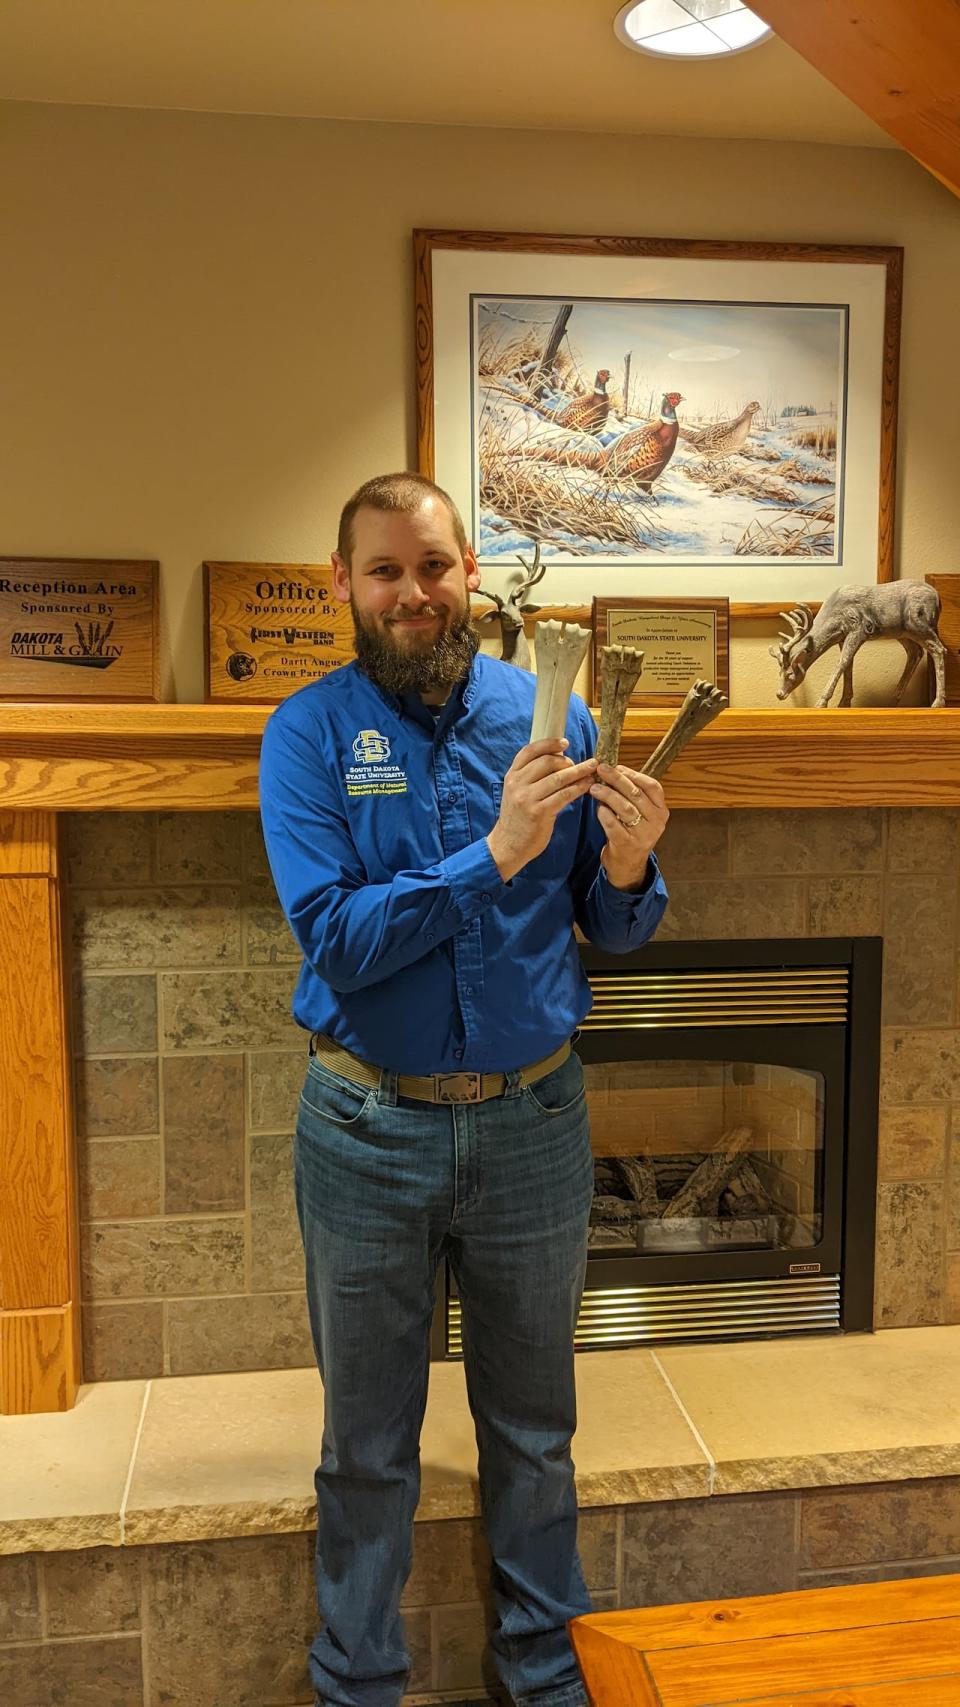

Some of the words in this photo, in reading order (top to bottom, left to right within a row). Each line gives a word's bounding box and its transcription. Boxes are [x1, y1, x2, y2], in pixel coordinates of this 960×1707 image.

[0, 579, 87, 596] Reception
[95, 582, 137, 595] Area
[255, 581, 329, 601] Office
[20, 602, 91, 615] Sponsored
[97, 604, 114, 616] By
[245, 603, 316, 616] Sponsored
[322, 604, 337, 617] By
[11, 632, 64, 645] DAKOTA
[283, 628, 335, 644] WESTERN
[10, 644, 51, 655] MILL
[53, 644, 65, 656] &
[68, 645, 124, 657] GRAIN
[311, 658, 342, 668] Angus
[263, 668, 296, 677] Crown
[300, 669, 328, 677] Partn
